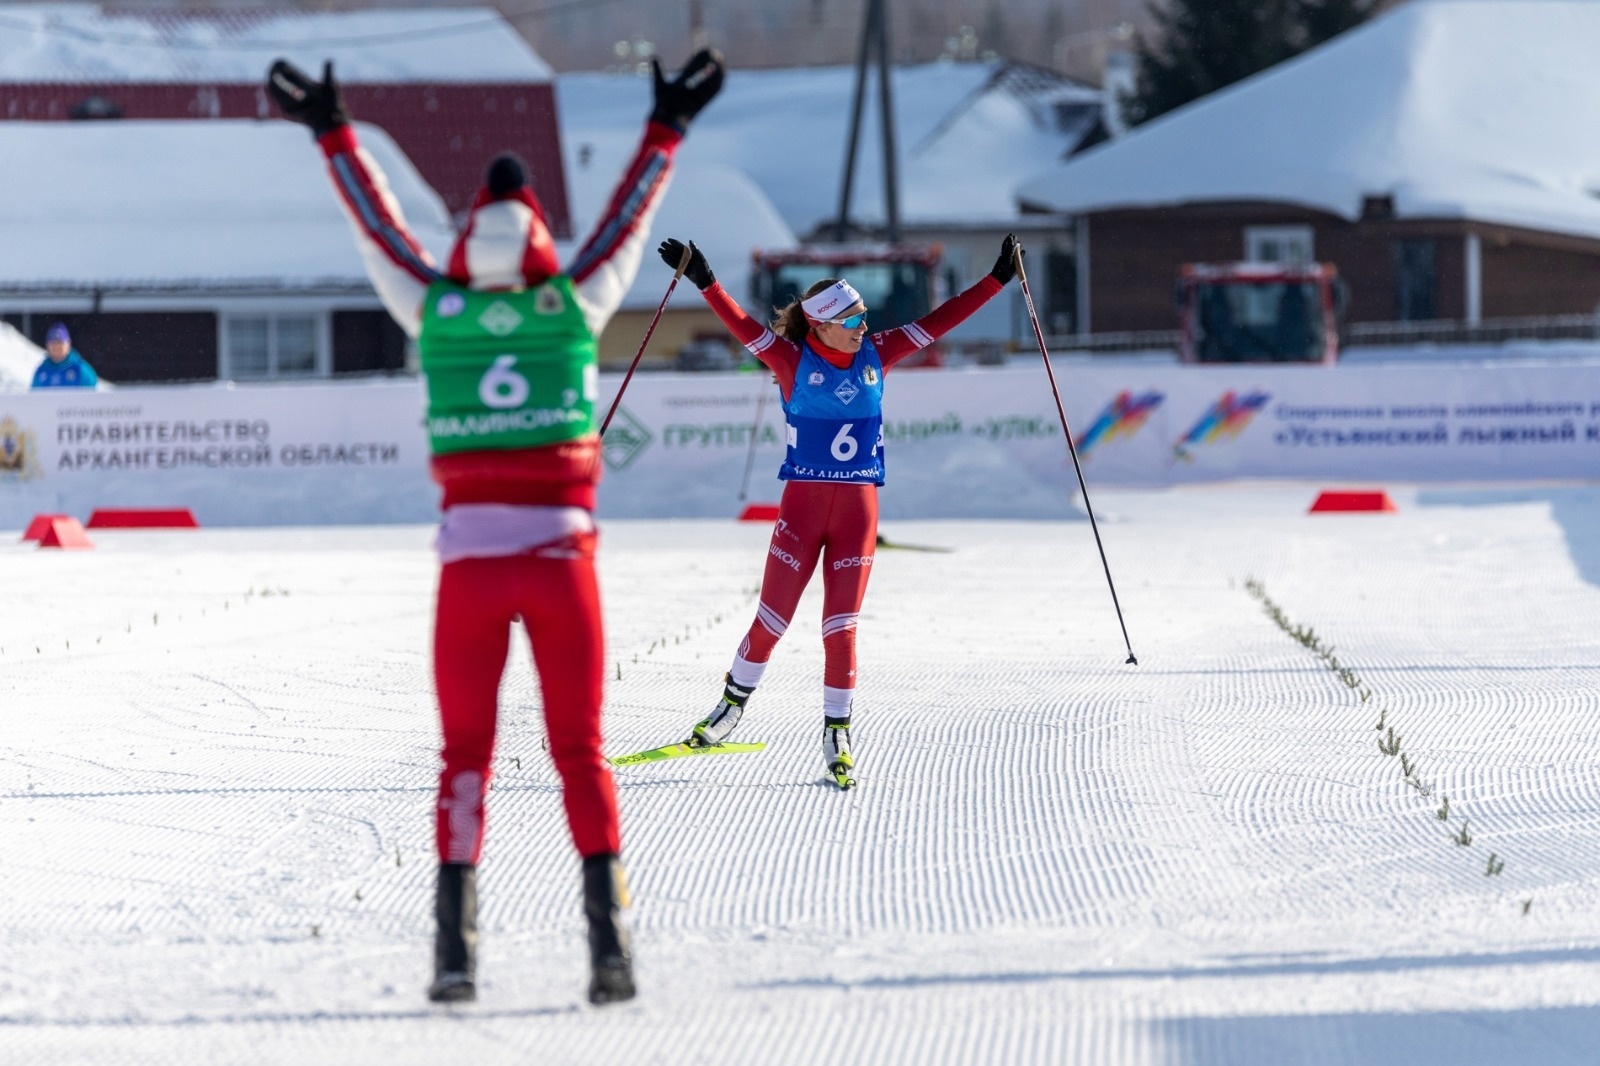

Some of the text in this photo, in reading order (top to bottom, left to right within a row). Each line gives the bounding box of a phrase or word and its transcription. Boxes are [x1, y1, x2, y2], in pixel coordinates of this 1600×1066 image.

[478, 354, 530, 409] 6
[56, 419, 270, 443] ПРАВИТЕЛЬСТВО
[661, 422, 778, 447] ГРУППА
[830, 423, 859, 462] 6
[57, 443, 399, 471] АРХАНГЕЛЬСКОЙ ОБЛАСТИ
